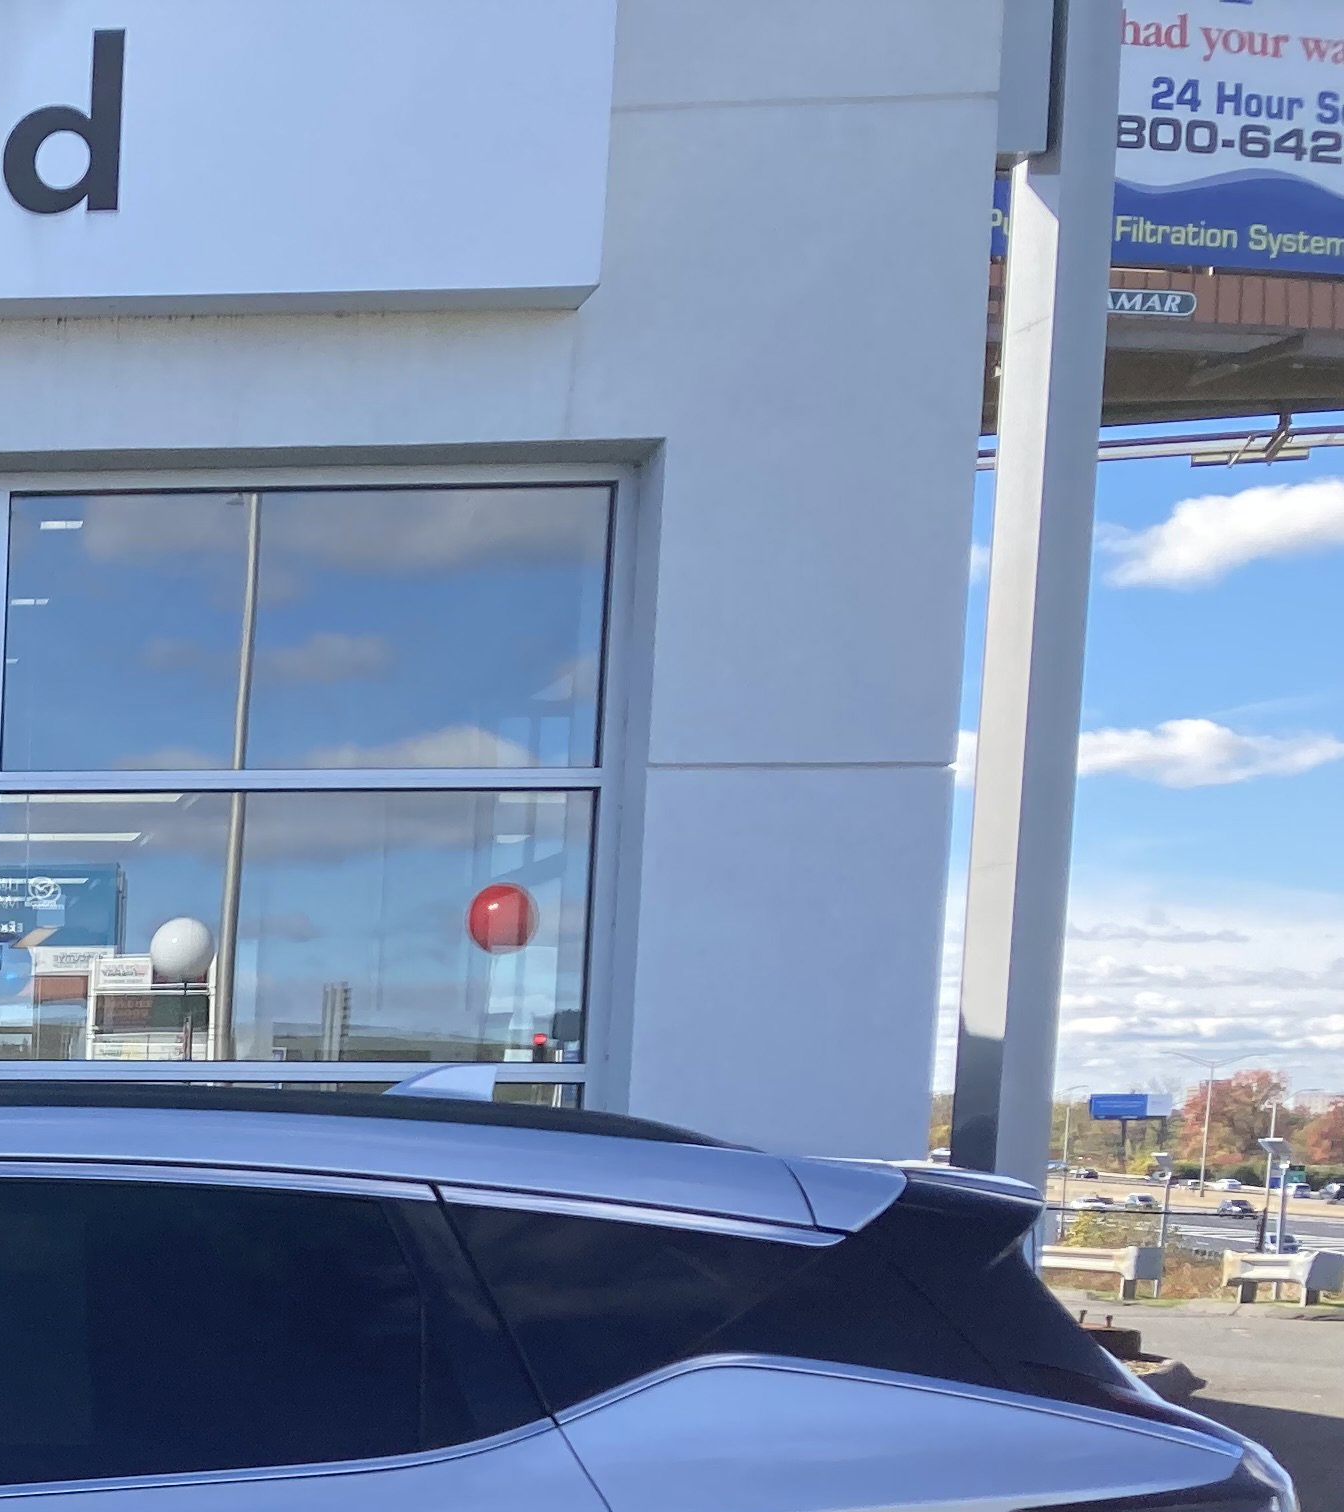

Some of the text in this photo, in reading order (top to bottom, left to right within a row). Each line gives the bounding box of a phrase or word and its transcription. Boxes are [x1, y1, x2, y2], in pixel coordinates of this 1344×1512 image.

[1120, 8, 1190, 49] had
[1199, 26, 1290, 62] your
[1151, 76, 1344, 126] 24 Hour S
[1114, 215, 1239, 249] Filtration
